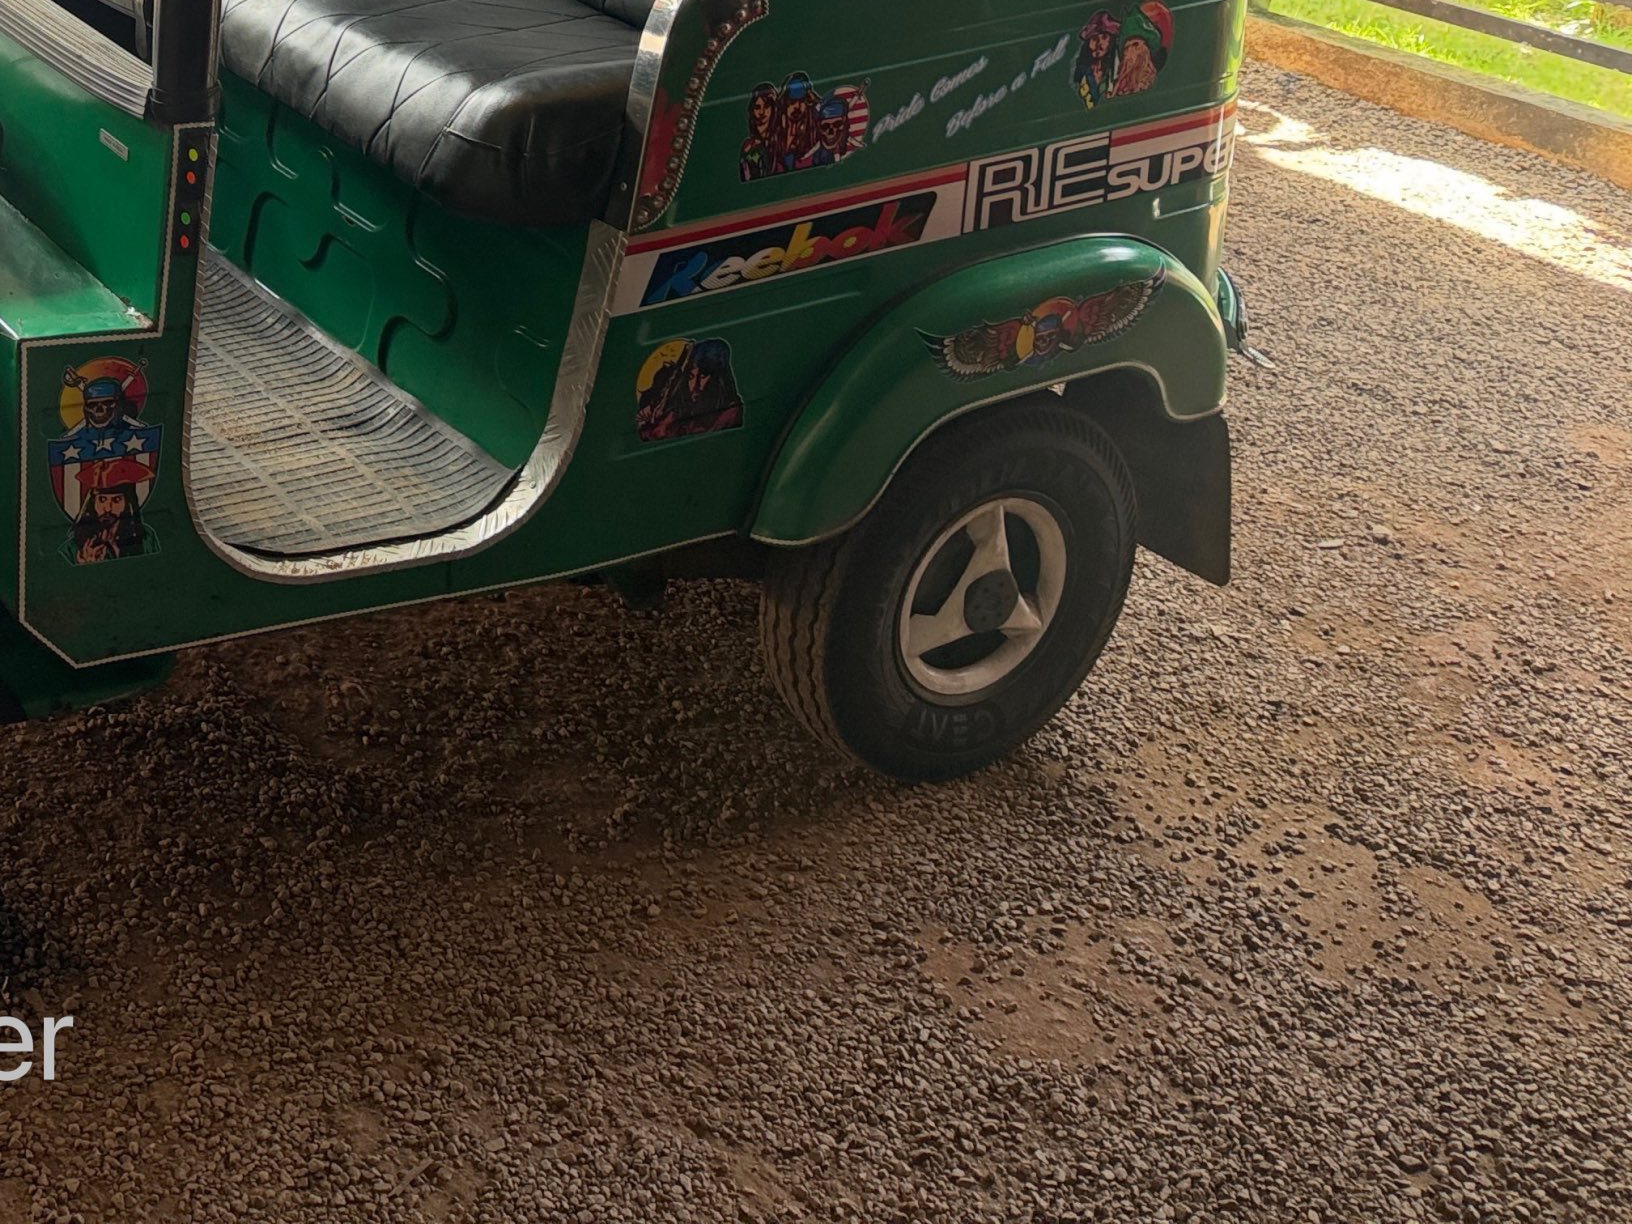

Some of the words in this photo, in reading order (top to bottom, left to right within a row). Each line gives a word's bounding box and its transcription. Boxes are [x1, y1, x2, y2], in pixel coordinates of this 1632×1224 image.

[871, 91, 925, 143] Pride
[945, 84, 1008, 138] Before
[1011, 71, 1027, 92] a
[1030, 33, 1070, 78] Fall
[964, 131, 1110, 234] RE
[1107, 135, 1234, 201] SUPE
[647, 200, 924, 303] Reebok
